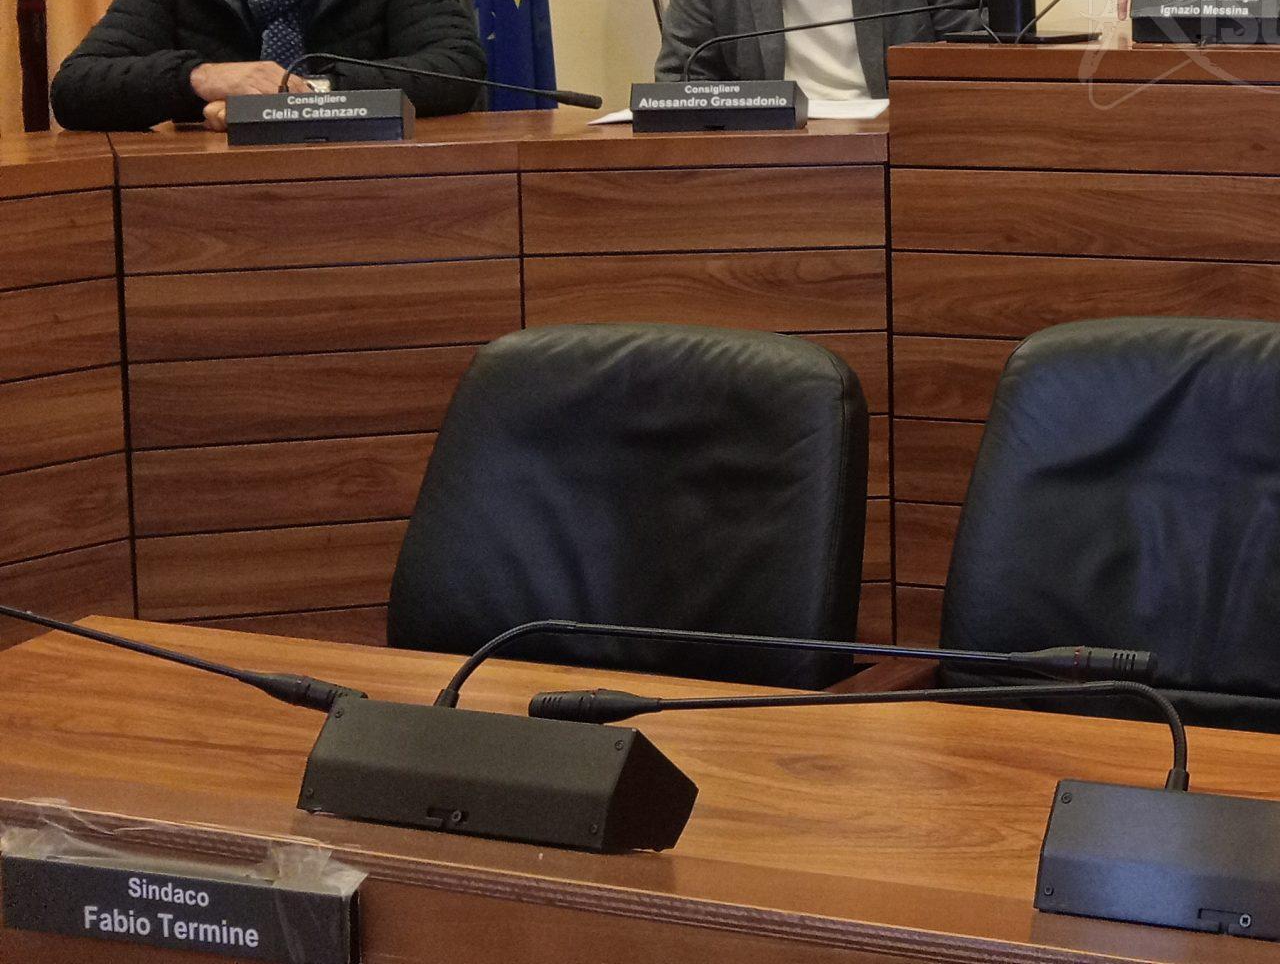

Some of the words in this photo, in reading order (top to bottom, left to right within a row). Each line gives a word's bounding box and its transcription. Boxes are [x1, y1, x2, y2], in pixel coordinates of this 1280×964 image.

[1160, 5, 1200, 17] Ignazio
[1203, 5, 1249, 16] Messina
[684, 84, 740, 95] Consigliere
[287, 94, 347, 106] Consigliere
[638, 97, 708, 109] Alessandro
[711, 96, 787, 108] Grassadonio
[262, 108, 299, 120] Clelia
[302, 106, 368, 119] Catanzaro
[128, 877, 209, 907] Sindaco
[84, 905, 150, 936] Fabio
[157, 913, 259, 948] Termine
